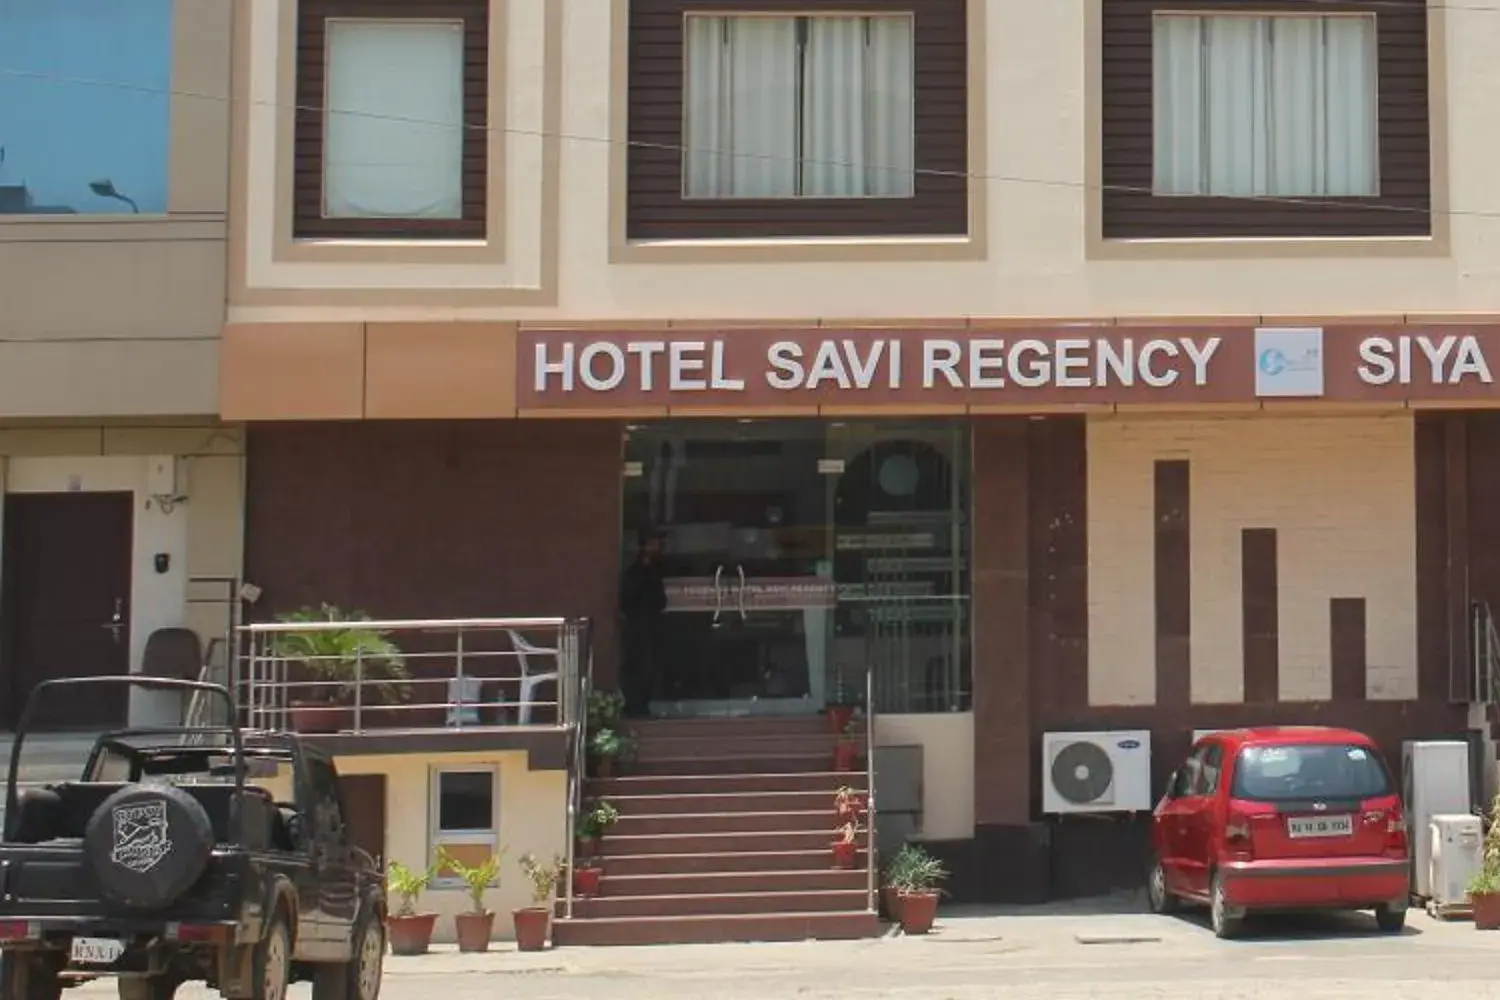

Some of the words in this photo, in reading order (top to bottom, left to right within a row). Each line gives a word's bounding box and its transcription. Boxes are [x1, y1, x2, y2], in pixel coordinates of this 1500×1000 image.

[534, 340, 746, 392] HOTEL
[764, 339, 901, 390] SAVI
[922, 336, 1222, 389] REGENCY
[1356, 334, 1493, 385] SIYA
